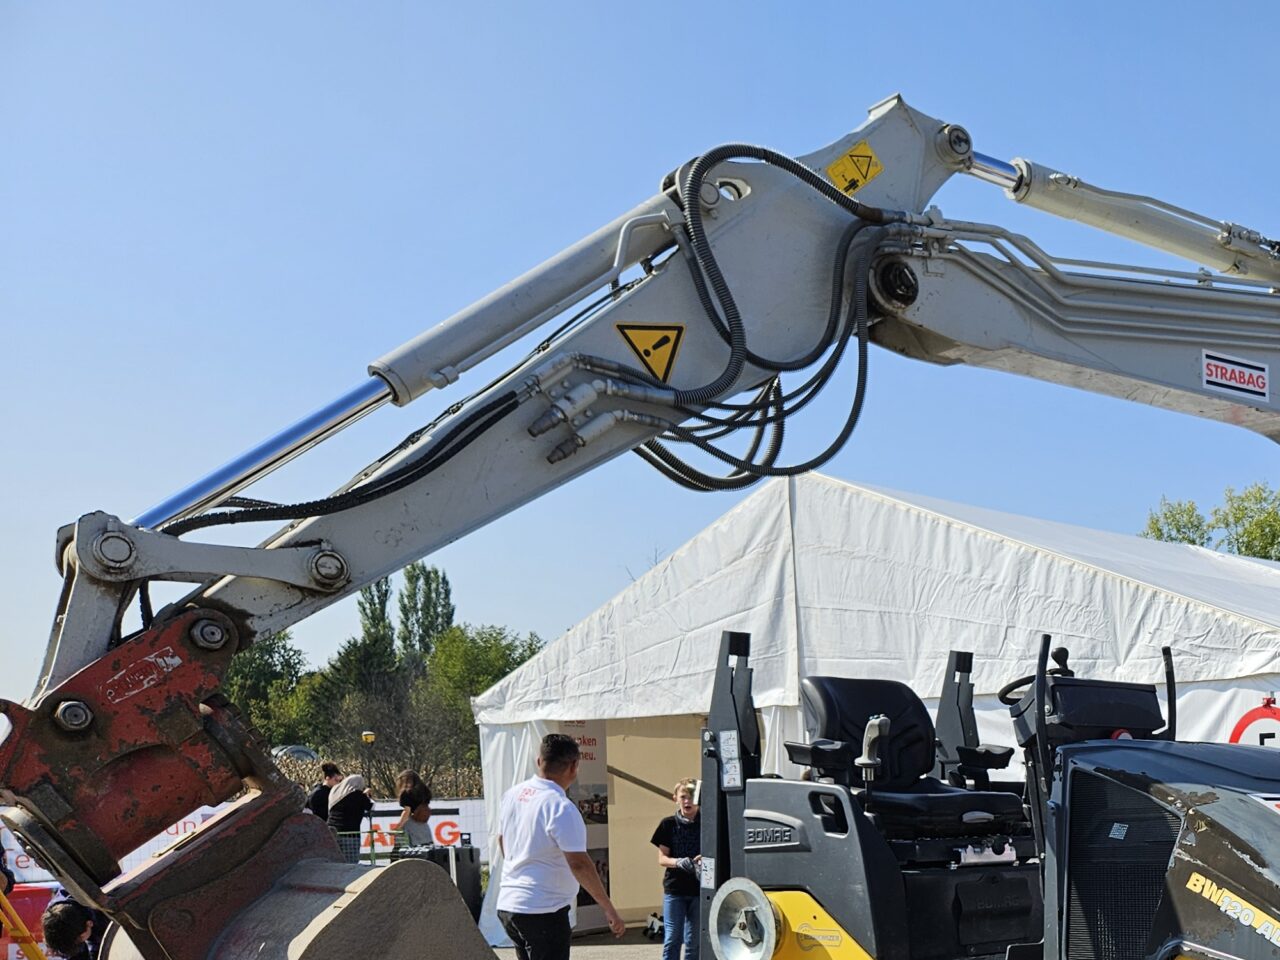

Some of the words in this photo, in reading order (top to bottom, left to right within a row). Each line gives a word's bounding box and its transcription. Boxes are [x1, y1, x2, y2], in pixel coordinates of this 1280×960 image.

[1205, 362, 1266, 389] STRABAG
[746, 828, 791, 843] BOMAG
[1185, 871, 1224, 905] BW
[1219, 896, 1255, 927] 120
